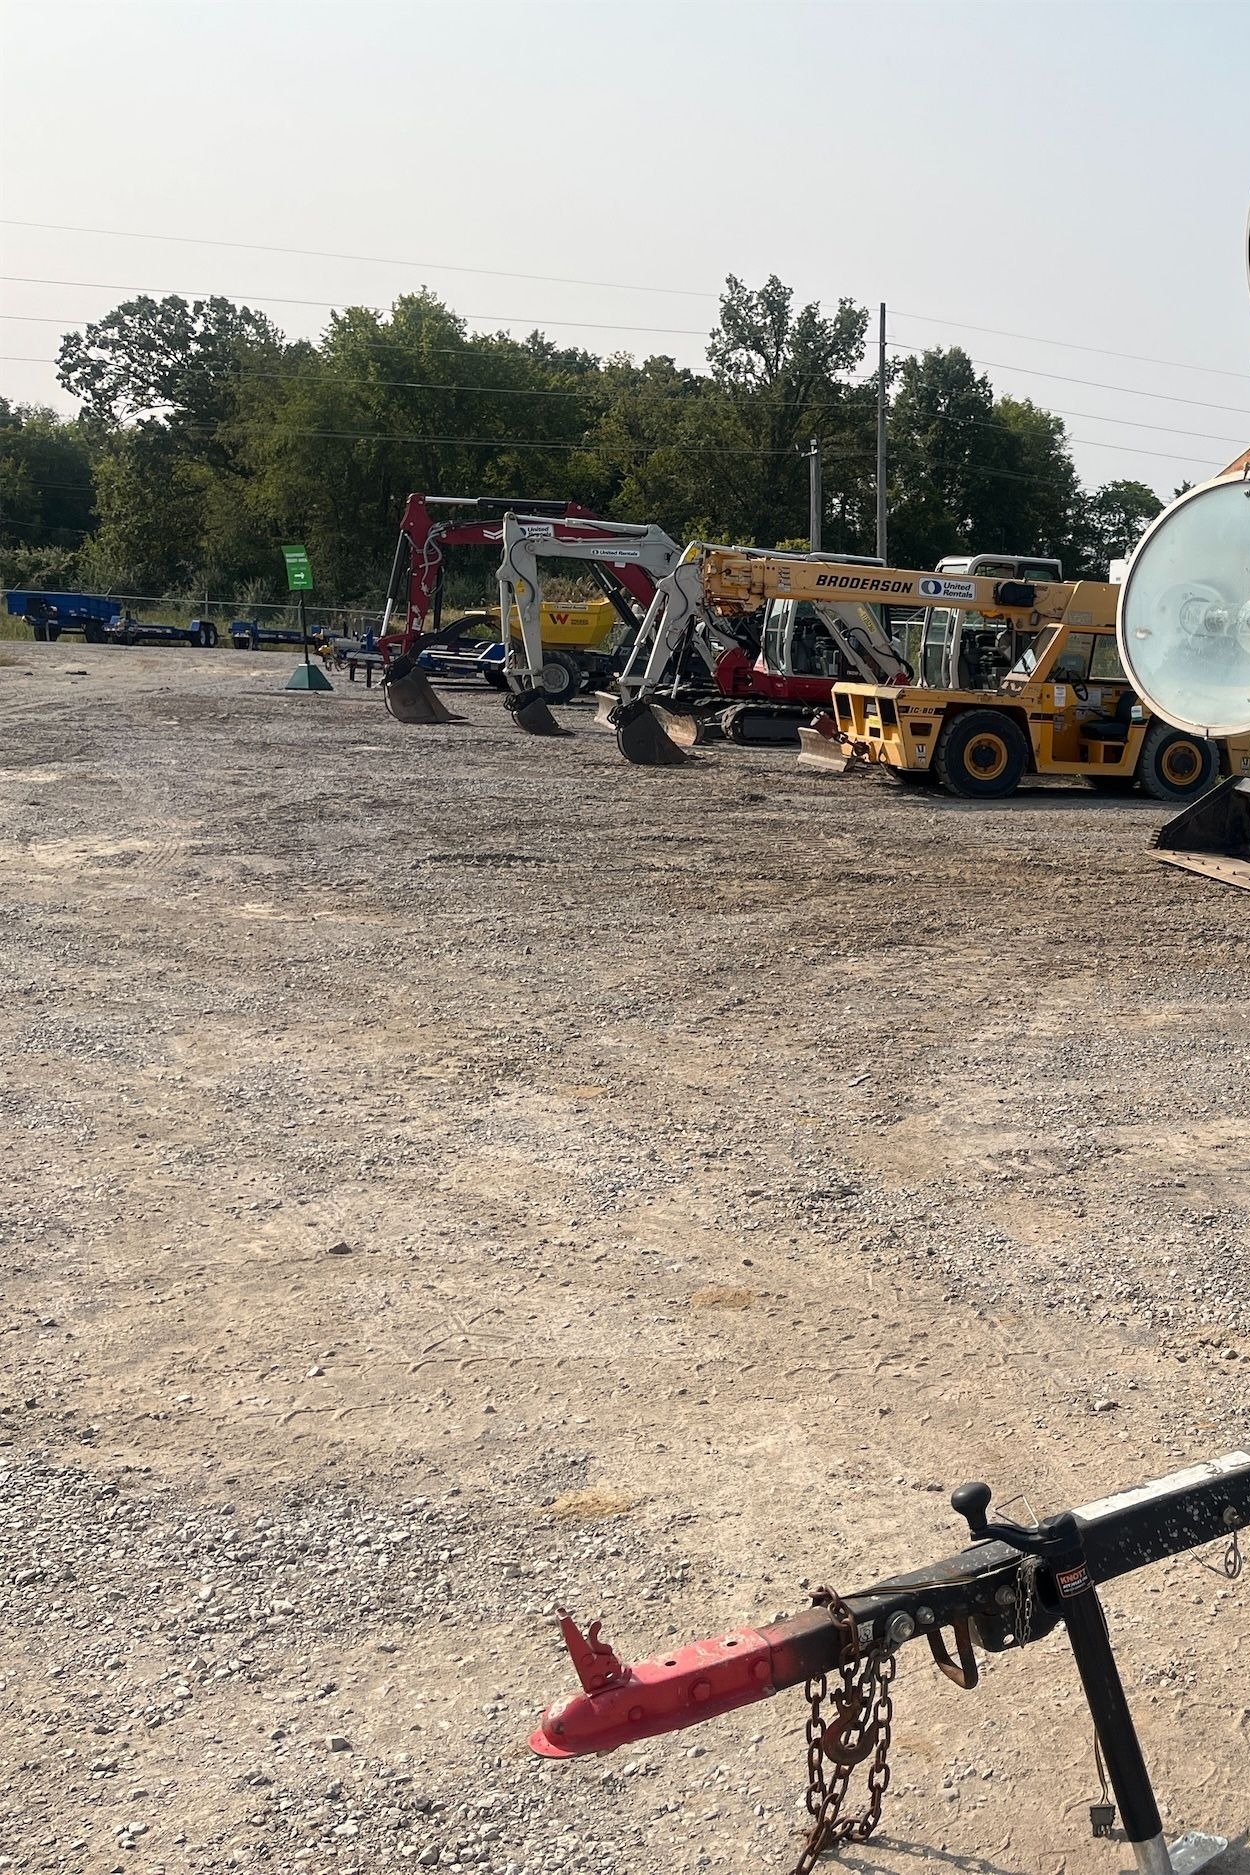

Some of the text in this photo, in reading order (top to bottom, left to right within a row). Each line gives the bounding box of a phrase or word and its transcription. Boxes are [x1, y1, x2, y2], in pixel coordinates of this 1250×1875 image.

[816, 575, 913, 594] BRODERSON
[943, 582, 971, 591] United
[943, 589, 973, 599] Rentals
